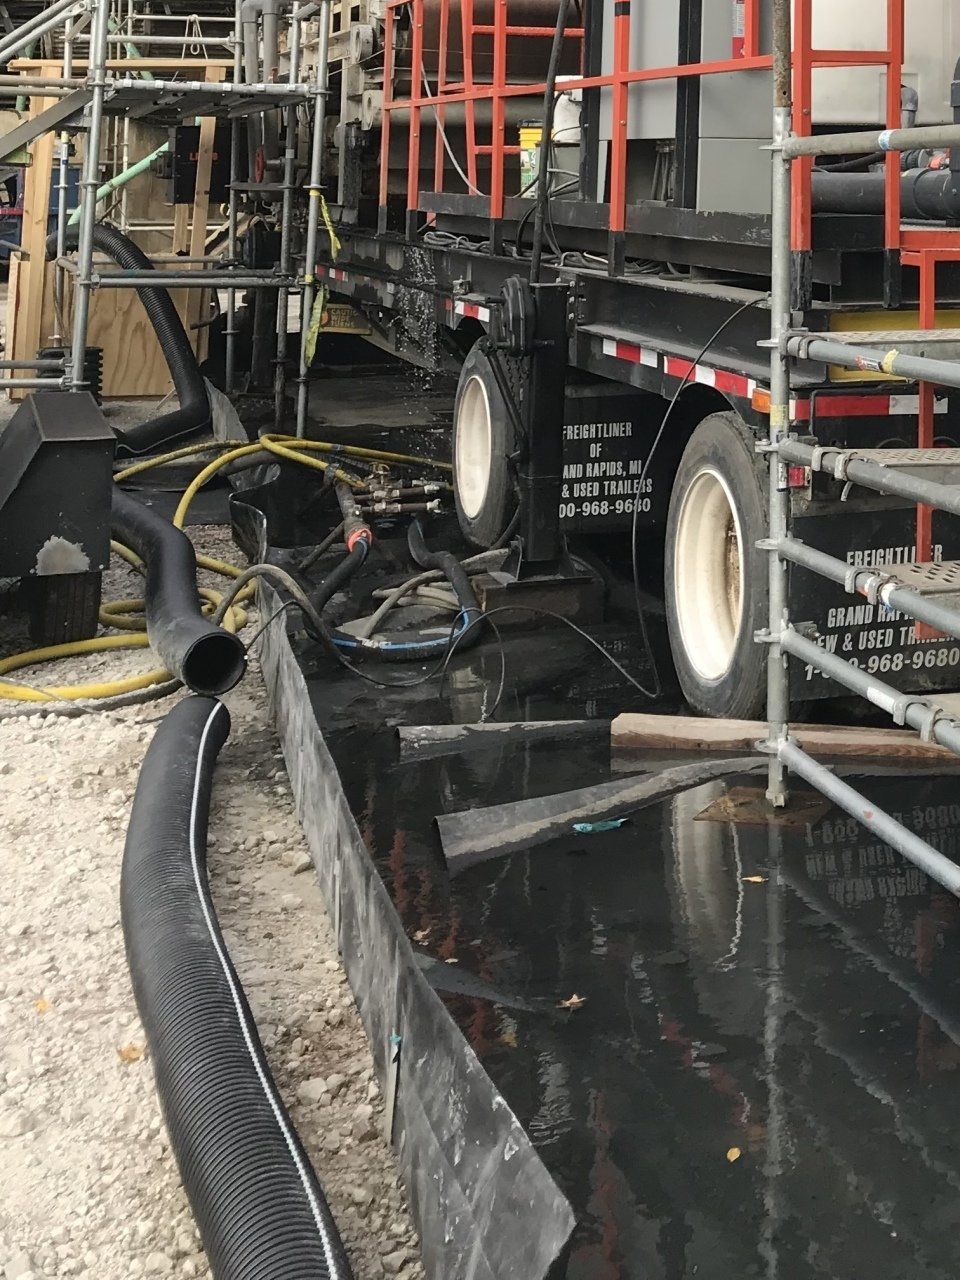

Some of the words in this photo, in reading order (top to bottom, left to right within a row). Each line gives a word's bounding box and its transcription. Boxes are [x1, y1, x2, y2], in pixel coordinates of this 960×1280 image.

[562, 422, 632, 440] FREIGHTLINER
[589, 443, 602, 458] OF
[585, 461, 627, 477] RAPIDS,
[628, 460, 642, 474] MI
[561, 483, 570, 498] &
[573, 481, 600, 497] USED
[827, 604, 874, 628] GRAND
[814, 633, 839, 654] EW
[842, 632, 853, 651] &
[858, 628, 894, 650] USED
